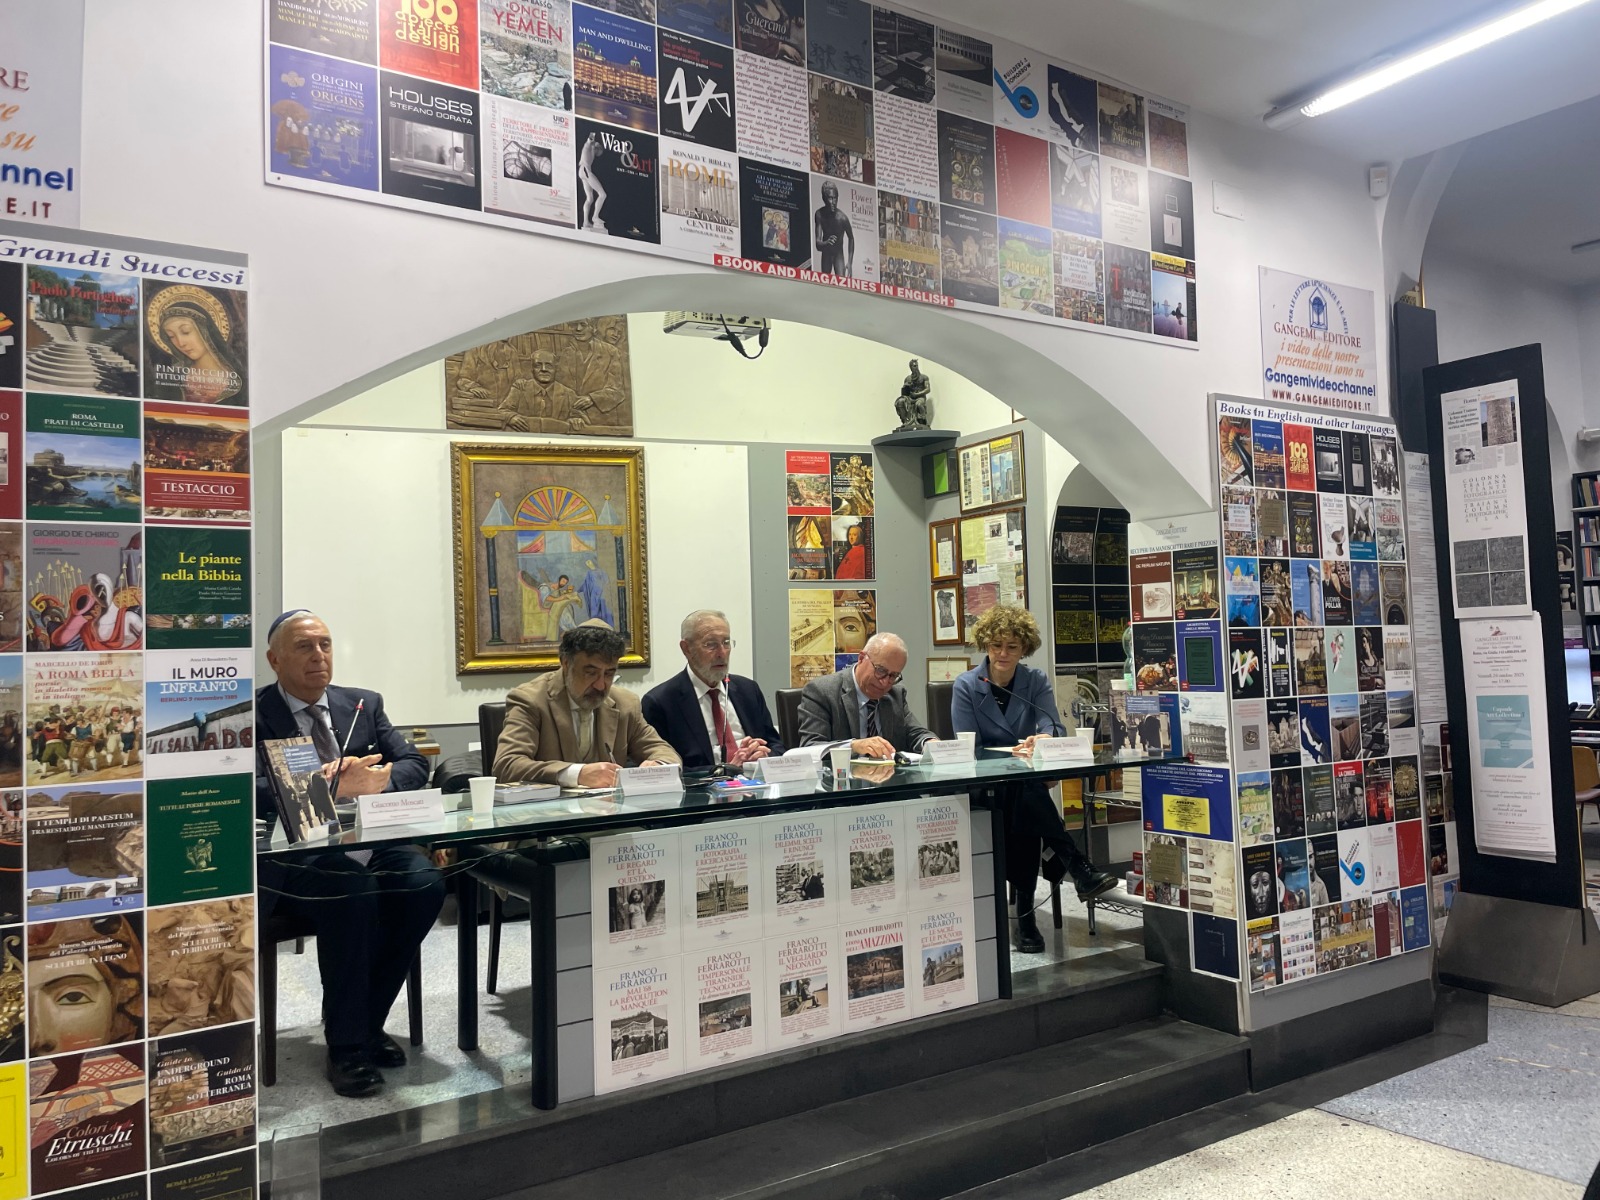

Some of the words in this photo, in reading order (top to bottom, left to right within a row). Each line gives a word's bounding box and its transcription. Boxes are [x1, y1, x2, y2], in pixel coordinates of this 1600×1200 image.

[509, 2, 548, 20] ONCE
[492, 8, 563, 43] YEMEN
[745, 11, 788, 35] Guercino
[395, 29, 459, 54] design
[578, 26, 596, 38] MAN
[598, 32, 614, 42] AND
[614, 35, 652, 52] DWELLING
[311, 72, 364, 91] ORIGINI
[1006, 63, 1032, 86] TOMORROW
[311, 90, 364, 108] ORIGINS
[389, 86, 473, 116] HOUSES
[390, 101, 434, 116] STEFANO
[436, 111, 473, 126] DORATA
[1112, 121, 1144, 138] Capuchin
[1, 131, 37, 152] su
[600, 132, 628, 154] War
[1112, 132, 1142, 150] Museum
[667, 157, 734, 190] ROME
[850, 188, 872, 204] Power
[850, 202, 874, 217] Pathos
[686, 218, 734, 234] CENTURIES
[0, 239, 110, 268] Grandi
[121, 254, 245, 285] Successi
[722, 256, 763, 273] BOOK
[768, 265, 796, 279] AND
[800, 270, 876, 292] MAGAZINES
[880, 284, 894, 296] IN
[898, 287, 948, 306] ENGLISH
[30, 279, 67, 298] Paolo
[70, 286, 136, 306] Portoghesi
[1274, 322, 1317, 340] GANGEMI
[1324, 329, 1362, 348] EDITORE
[1287, 340, 1310, 356] video
[1312, 343, 1332, 360] delle
[1334, 351, 1360, 364] nostre
[156, 364, 238, 380] PINTORICCHIO
[1274, 354, 1332, 374] presentazioni
[1355, 368, 1364, 378] su
[1265, 368, 1376, 396] Gangemivideochannel
[1272, 390, 1371, 412] WWW.GANGEMIEDITORE.IT
[44, 418, 69, 426] PRATI
[82, 420, 124, 430] CASTELLO
[1220, 402, 1252, 416] Books
[1254, 408, 1264, 418] in
[1266, 409, 1302, 423] English
[1304, 416, 1324, 427] and
[1326, 417, 1350, 429] other
[1351, 420, 1395, 438] languages
[1316, 434, 1340, 444] HOUSES
[1288, 441, 1308, 458] 100
[1462, 474, 1506, 484] COLONNA
[162, 482, 235, 495] TESTACCIO
[1379, 514, 1400, 524] YEMEN
[33, 530, 70, 538] GIORGIO
[72, 530, 84, 538] DE
[84, 530, 119, 539] CHIRICO
[179, 552, 197, 564] Le
[200, 552, 242, 568] piante
[161, 568, 194, 581] nella
[198, 569, 242, 582] Bibbia
[35, 672, 44, 680] A
[50, 670, 88, 679] ROMA
[91, 668, 135, 678] BELLA
[172, 668, 186, 680] IL
[190, 666, 238, 678] MURO
[160, 680, 238, 694] INFRANTO
[371, 800, 400, 810] Giacomo
[400, 798, 424, 807] Moscati
[924, 806, 951, 816] FRANCO
[44, 817, 78, 826] TEMPLI
[80, 816, 90, 824] DI
[92, 812, 134, 822] PAESTUM
[856, 814, 886, 824] FRANCO
[916, 812, 958, 823] FERRAROTTI
[47, 826, 80, 834] RESTAURO
[88, 820, 139, 830] MANUTENZIONE
[783, 822, 815, 832] FRANCO
[848, 820, 893, 832] FERRAROTTI
[860, 828, 883, 837] DALLO
[704, 832, 738, 844] FRANCO
[774, 828, 822, 841] FERRAROTTI
[852, 834, 892, 845] STRANIERO
[618, 842, 655, 854] FRANCO
[695, 838, 747, 852] FERRAROTTI
[858, 840, 894, 850] SALVEZZA
[608, 849, 665, 864] FERRAROTTI
[700, 856, 724, 865] RICERCA
[724, 854, 748, 862] SOCIALE
[703, 848, 740, 858] FOTOGRAFIA
[626, 858, 657, 870] REGARD
[618, 873, 656, 885] QUESTION
[920, 917, 962, 930] FERRAROTTI
[928, 912, 956, 923] FRANCO
[846, 928, 868, 938] FRANCO
[868, 921, 904, 934] FERRAROTTI
[938, 930, 962, 941] POUVOIR
[80, 937, 114, 946] Nazionale
[787, 936, 819, 948] FRANCO
[860, 932, 904, 950] AMAZZONIA
[61, 947, 88, 956] Palazzo
[98, 942, 123, 951] Venezia
[182, 942, 232, 956] TERRACOTTA
[778, 942, 828, 958] FERRAROTTI
[44, 960, 88, 970] SCULTURE
[89, 957, 99, 965] IN
[100, 952, 127, 963] LEGNO
[707, 950, 742, 964] FRANCO
[786, 950, 828, 964] VEGLIARDO
[698, 956, 750, 974] FERRAROTTI
[786, 959, 822, 972] NEONATO
[620, 966, 658, 981] FRANCO
[698, 966, 750, 982] L'IMPERSONALE
[705, 974, 744, 986] TIRANNIDE
[610, 972, 668, 992] FERRAROTTI
[699, 980, 750, 995] TECNOLOGICA
[610, 999, 618, 1007] LA
[156, 1059, 182, 1068] Guide
[157, 1056, 230, 1079] UNDERGROUND
[216, 1067, 241, 1078] Guida
[226, 1074, 252, 1085] ROMA
[157, 1075, 185, 1087] ROME
[186, 1082, 252, 1102] SOTTERRANEA
[66, 1120, 108, 1140] Colori
[46, 1123, 134, 1158] Etruschi
